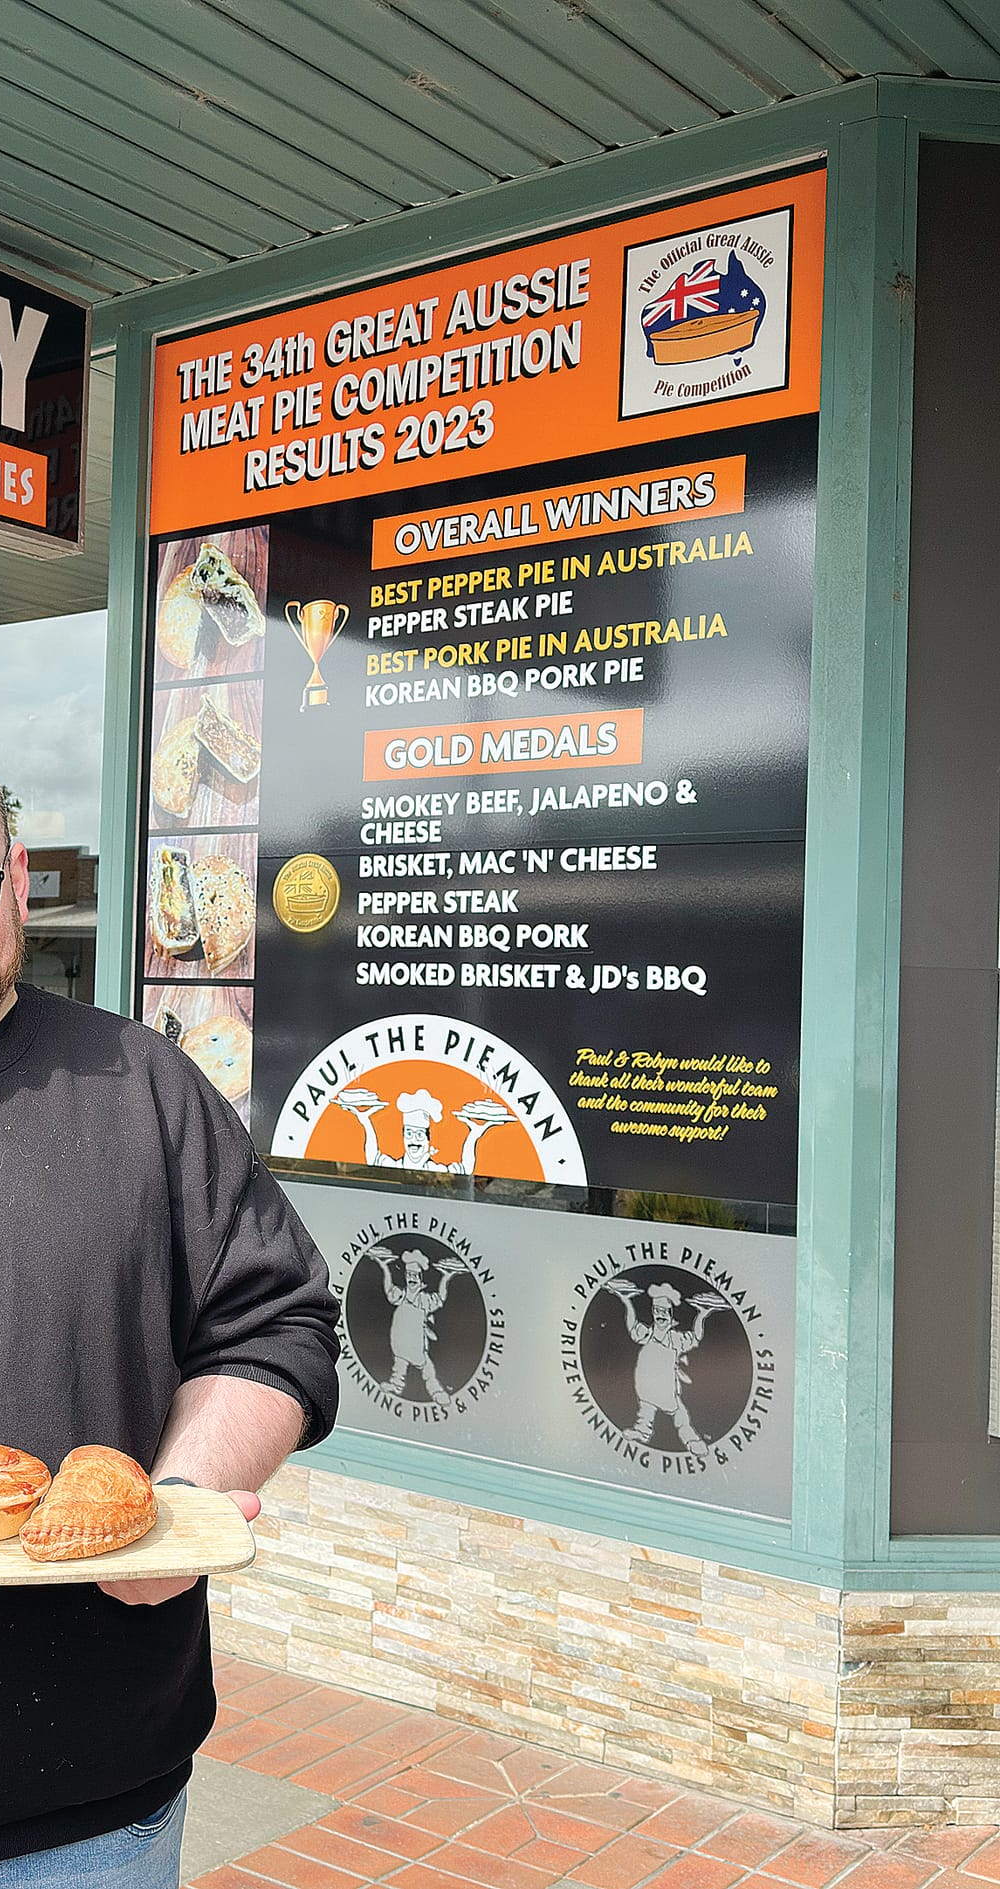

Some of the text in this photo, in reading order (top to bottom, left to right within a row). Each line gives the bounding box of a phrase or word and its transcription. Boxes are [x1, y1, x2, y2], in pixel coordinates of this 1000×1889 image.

[638, 232, 774, 294] The Official Great Aussie
[178, 258, 591, 402] THE 34th GREAT AUSSIE
[181, 320, 582, 453] MEAT PIE COMPETITION
[654, 362, 752, 398] Pie Competition
[246, 400, 495, 491] RESULTS 2023
[395, 473, 716, 555] OVERALL WINNERS
[370, 530, 754, 609] BEST PEPPER PIE IN AUSTRALIA
[368, 590, 574, 639] PEPPER STEAK PIE
[366, 613, 728, 676] BEST PORK PIE IN AUSTRALIA
[365, 657, 644, 707] KOREAN BBQ PORK PIE
[384, 722, 618, 771] GOLD MEDALS
[361, 779, 698, 820] SMOKEY BEEF, JALAPENO &
[360, 820, 442, 845] CHEESE
[359, 852, 454, 880] BRISKET,
[458, 850, 516, 875] MAC
[522, 849, 554, 873] 'N'
[560, 845, 657, 872] CHEESE
[358, 889, 519, 915] PEPPER STEAK
[356, 924, 590, 952] KOREAN BBQ PORK
[355, 962, 707, 996] SMOKED BRISKET & JD's BBQ
[293, 1025, 563, 1142] PAUL THE PIEMAN
[569, 1070, 778, 1101] thank all their wonderful team
[576, 1048, 771, 1075] Paul & Robyn would like to
[577, 1093, 768, 1123] and the community for their
[610, 1120, 729, 1143] awesome support!
[341, 1213, 495, 1284] PAUL THE PIEMAN
[574, 1242, 762, 1323] PAUL THE PIEMAN
[413, 1406, 448, 1423] PIES
[455, 1398, 467, 1414] &
[468, 1308, 505, 1401] PASTRIES
[662, 1455, 706, 1474] PIES
[714, 1447, 729, 1466] &
[729, 1349, 775, 1452] PASTRIES
